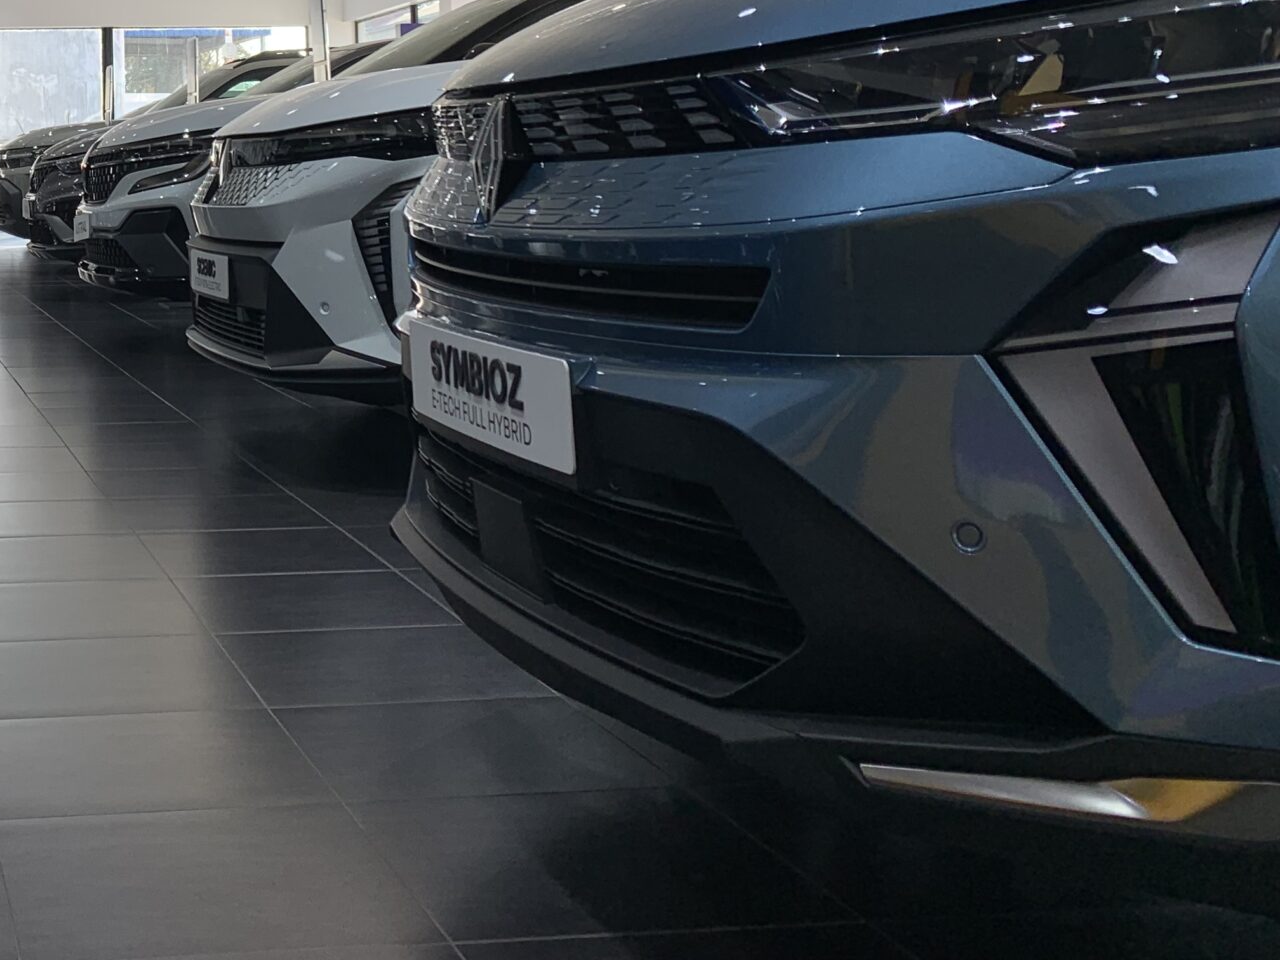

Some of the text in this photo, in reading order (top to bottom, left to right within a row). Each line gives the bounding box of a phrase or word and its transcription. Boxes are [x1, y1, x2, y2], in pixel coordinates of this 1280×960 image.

[430, 340, 524, 412] SYMBIOZ
[431, 388, 533, 446] E-TECH FULL HYBRID
